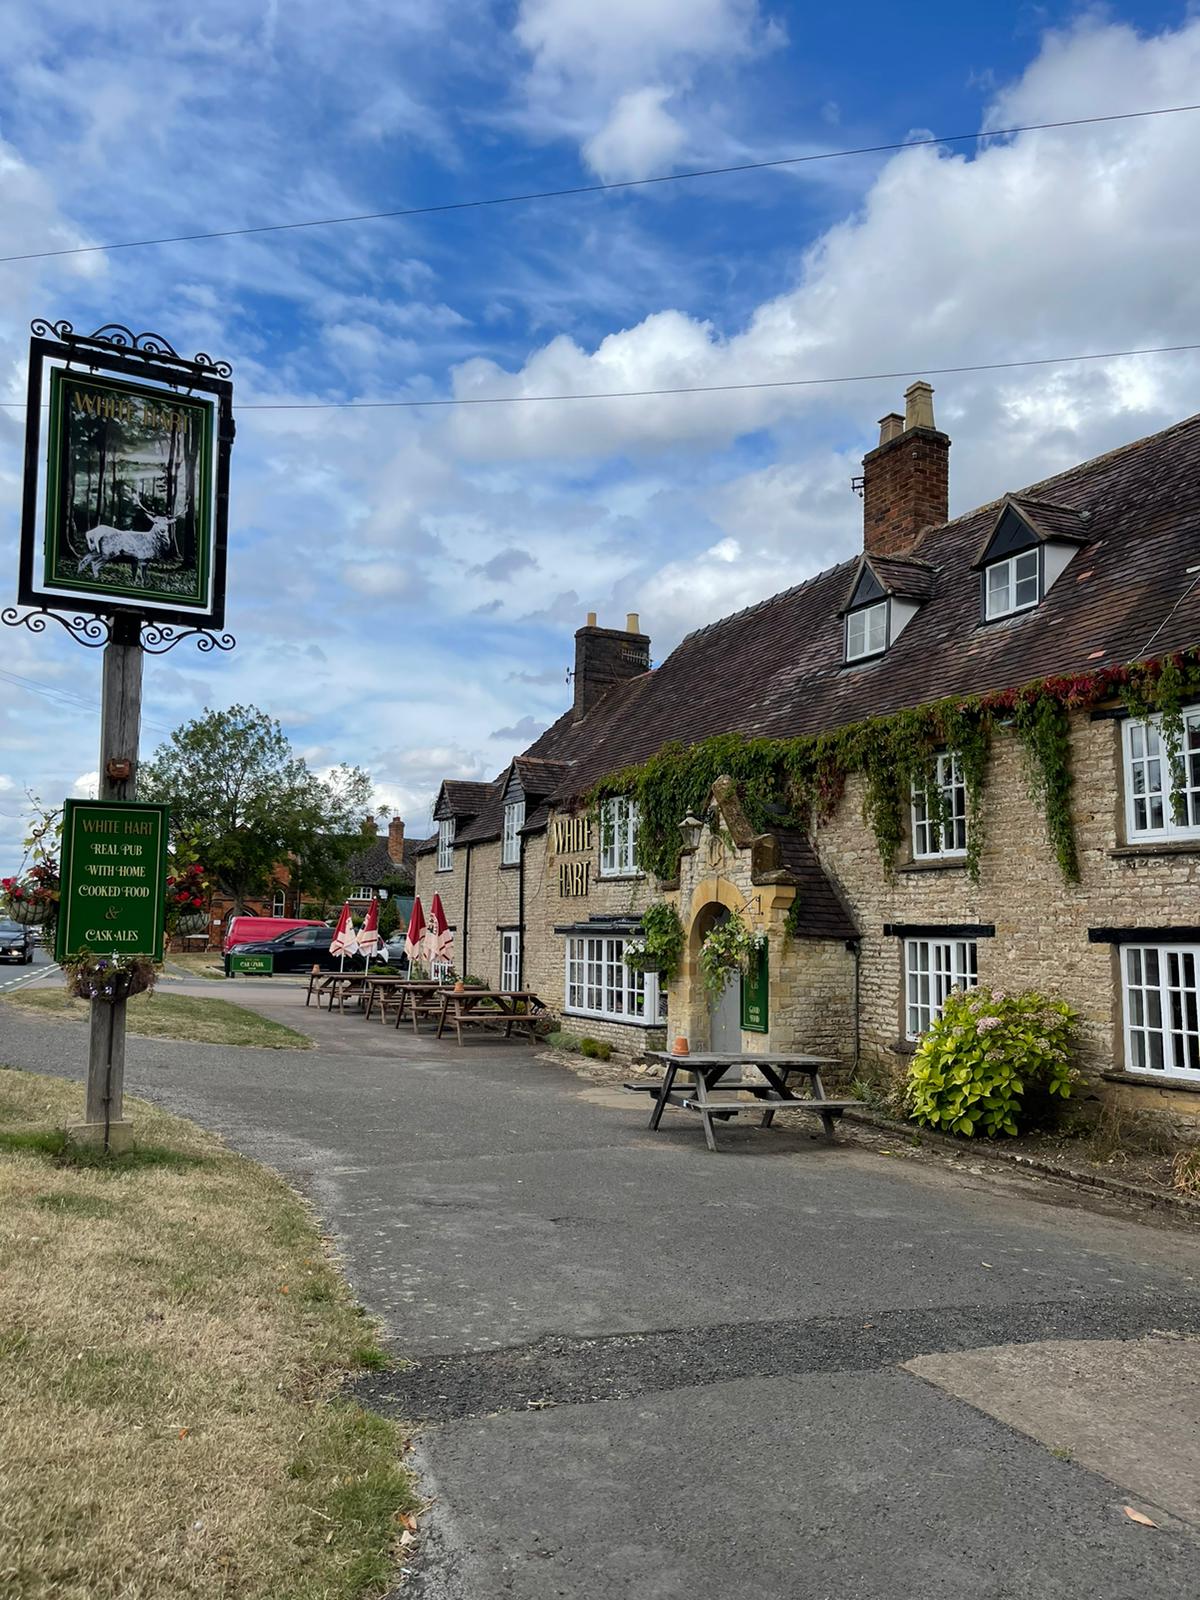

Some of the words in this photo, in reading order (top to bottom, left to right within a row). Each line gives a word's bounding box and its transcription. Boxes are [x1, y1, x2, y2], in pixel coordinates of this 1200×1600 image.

[75, 391, 133, 421] WHITE
[143, 404, 189, 434] HART
[83, 820, 120, 834] WHITE
[124, 821, 154, 835] HART
[553, 816, 593, 854] WHITE
[90, 843, 119, 855] REAL
[120, 844, 143, 856] PUB
[85, 865, 114, 877] WITH
[115, 865, 146, 877] HOME
[559, 861, 590, 897] HART
[78, 885, 120, 897] COOKED
[121, 886, 150, 898] FOOD
[105, 905, 123, 920] &
[85, 929, 113, 941] CASK
[113, 930, 139, 941] ALES
